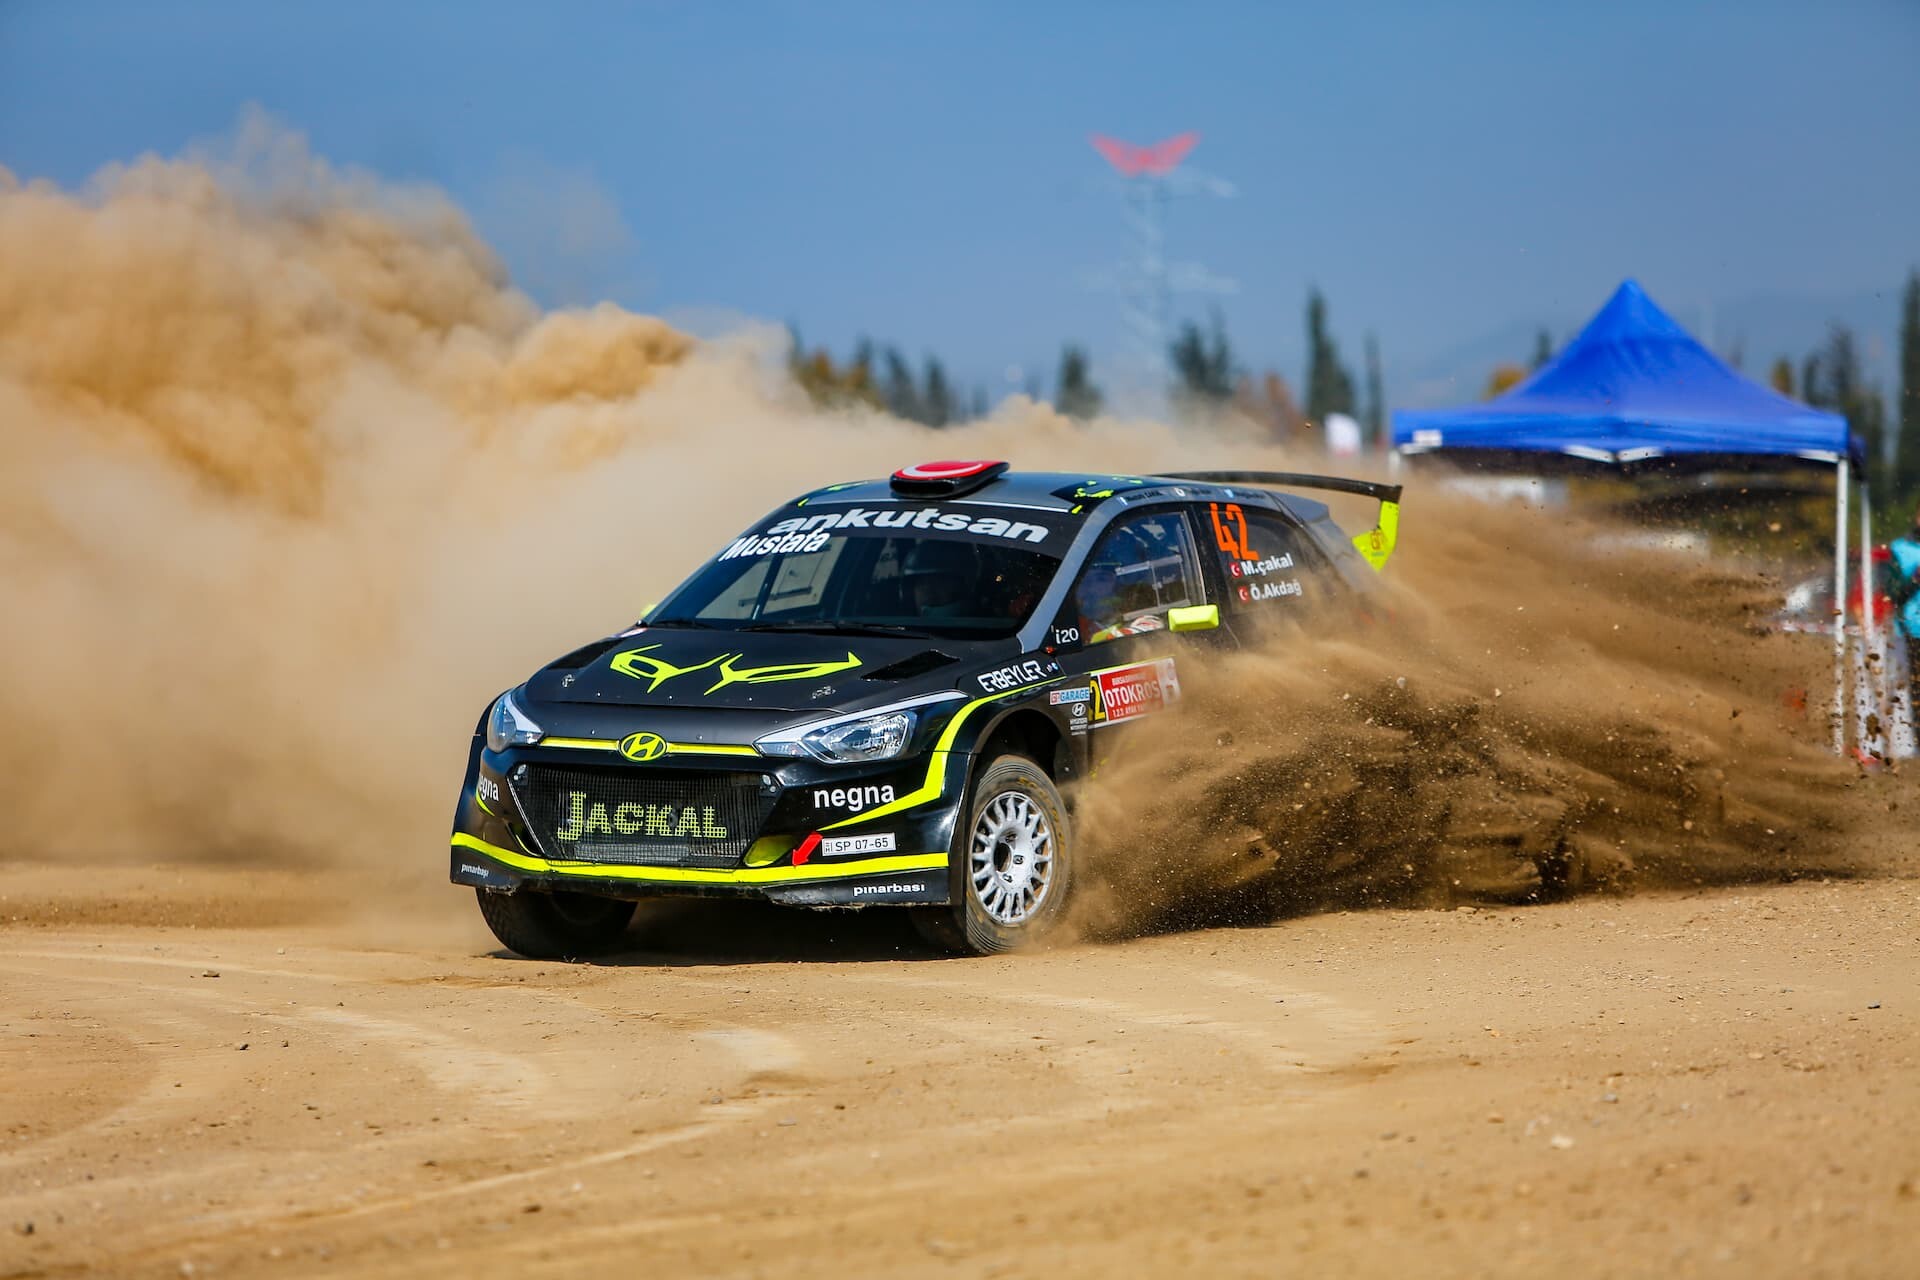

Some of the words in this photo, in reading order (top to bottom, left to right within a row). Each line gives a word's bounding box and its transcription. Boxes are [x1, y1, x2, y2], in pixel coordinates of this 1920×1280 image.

[767, 508, 1049, 543] ankutsan
[1210, 503, 1260, 560] 42
[718, 528, 831, 562] Mustafa
[1241, 553, 1294, 576] M.çakal
[1250, 579, 1302, 600] Ö.Akdağ
[1055, 627, 1079, 644] i20
[977, 660, 1047, 692] ERBEYLER
[1060, 688, 1089, 702] GARAGE
[813, 784, 895, 812] negna
[557, 791, 727, 841] JACKAL
[835, 841, 851, 852] SP
[855, 837, 889, 850] 07-65
